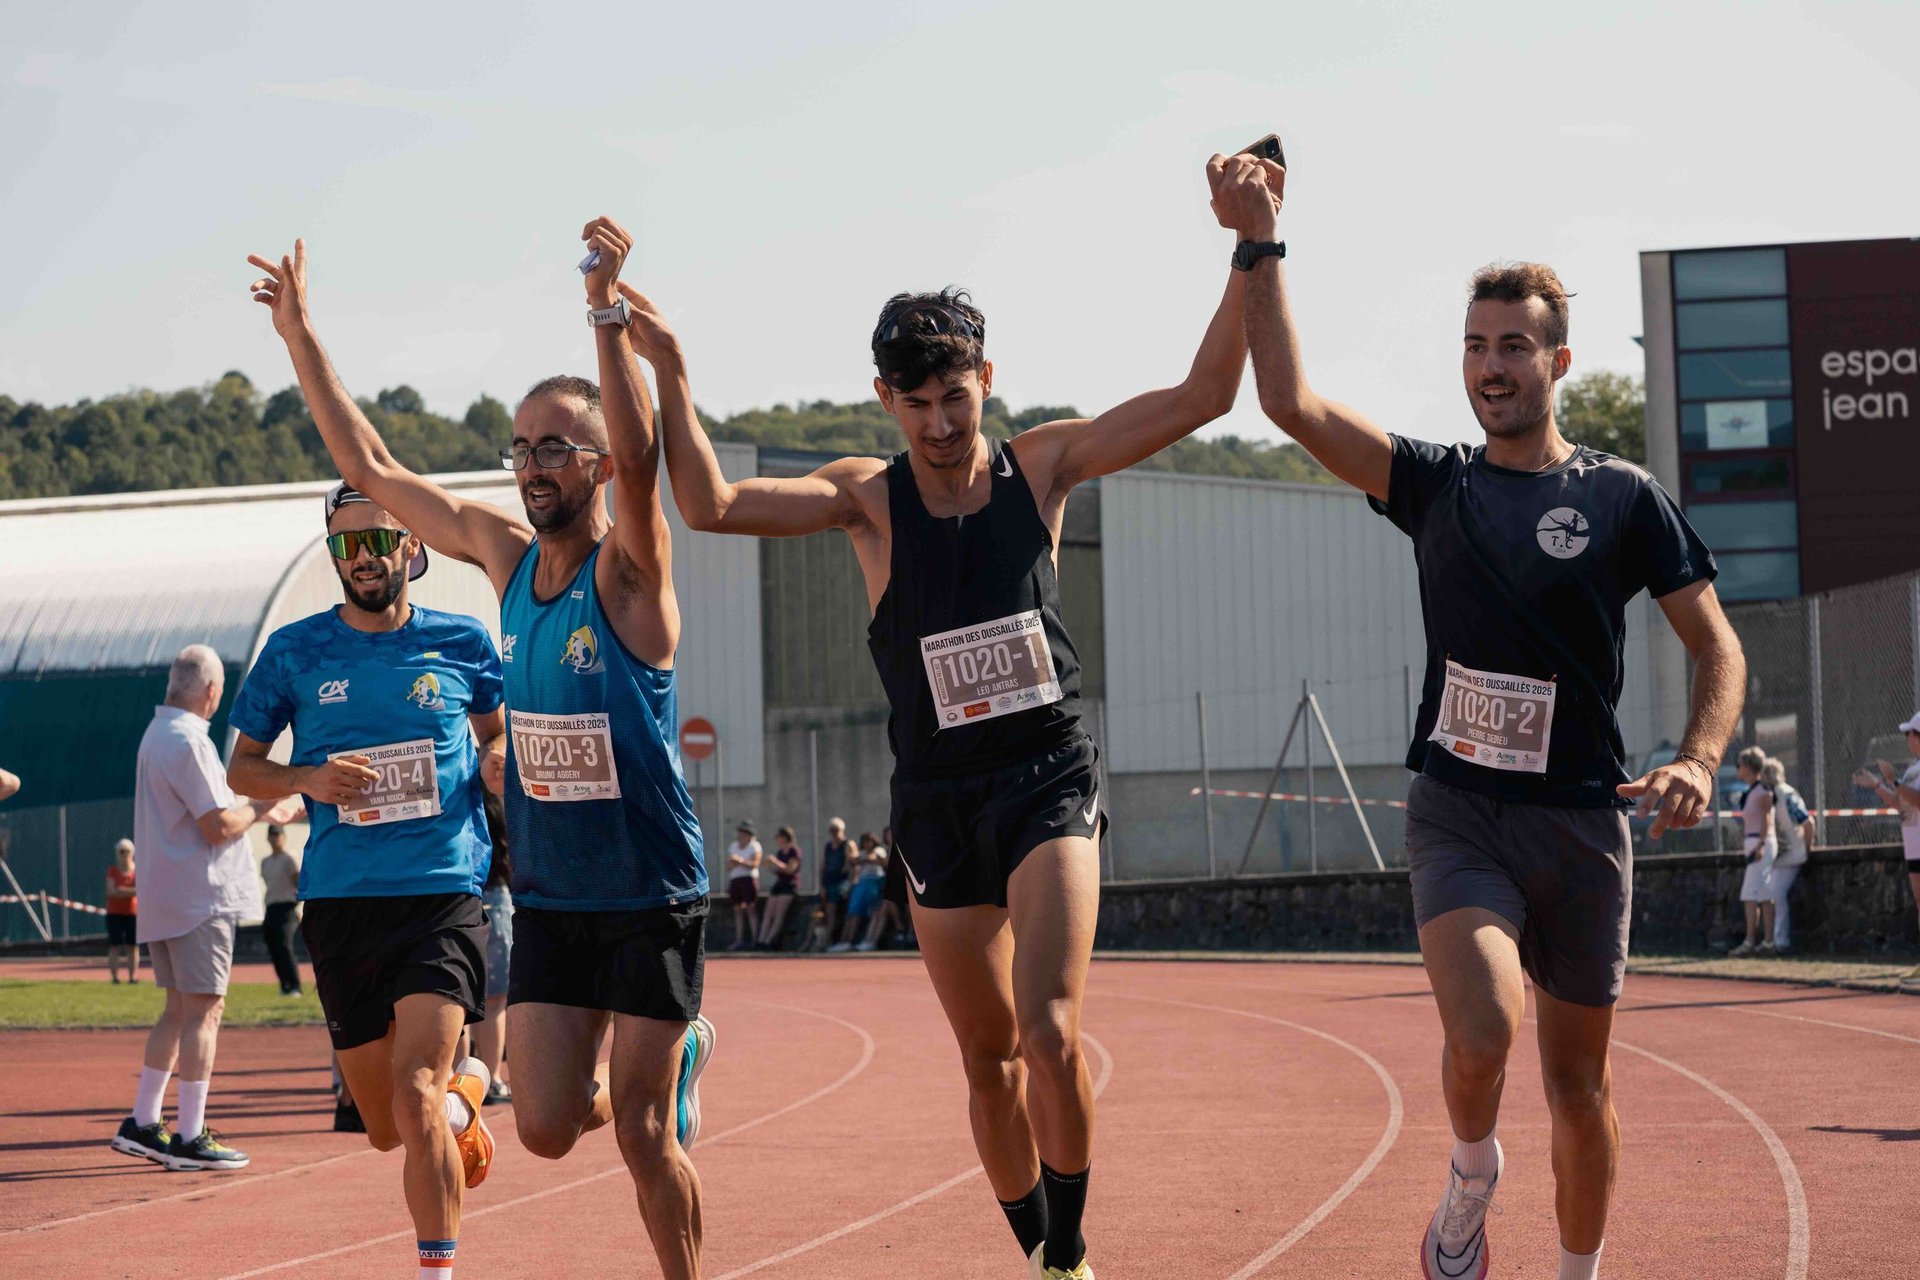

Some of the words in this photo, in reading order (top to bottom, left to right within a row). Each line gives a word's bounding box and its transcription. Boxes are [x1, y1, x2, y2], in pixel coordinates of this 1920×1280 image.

[1821, 347, 1920, 386] espa
[1823, 387, 1909, 430] jean
[924, 635, 965, 653] MARATHON
[965, 631, 981, 643] DES
[981, 620, 1024, 639] OUSSAILLÈS
[1024, 616, 1040, 628] 2025
[944, 636, 1039, 688] 1020-1
[976, 686, 990, 696] LEO
[992, 678, 1019, 692] ANTRAS
[1448, 666, 1473, 684] MARATHON
[1472, 676, 1485, 688] DES
[1485, 679, 1531, 694] OUSSAILLÈS
[1531, 685, 1552, 696] 2025
[535, 719, 546, 729] DES
[546, 718, 586, 730] OUSSAILLÈS
[587, 719, 607, 729] 2025
[1456, 688, 1537, 735] 1020-2
[1467, 727, 1486, 741] PIERRE
[378, 745, 415, 759] OUSSAILLÈS
[415, 744, 432, 754] 2025
[520, 734, 599, 767] 1020-3
[361, 759, 425, 795] 20-4
[535, 770, 555, 779] BRUNO
[557, 770, 581, 779] AGGERY
[369, 795, 385, 805] YANN
